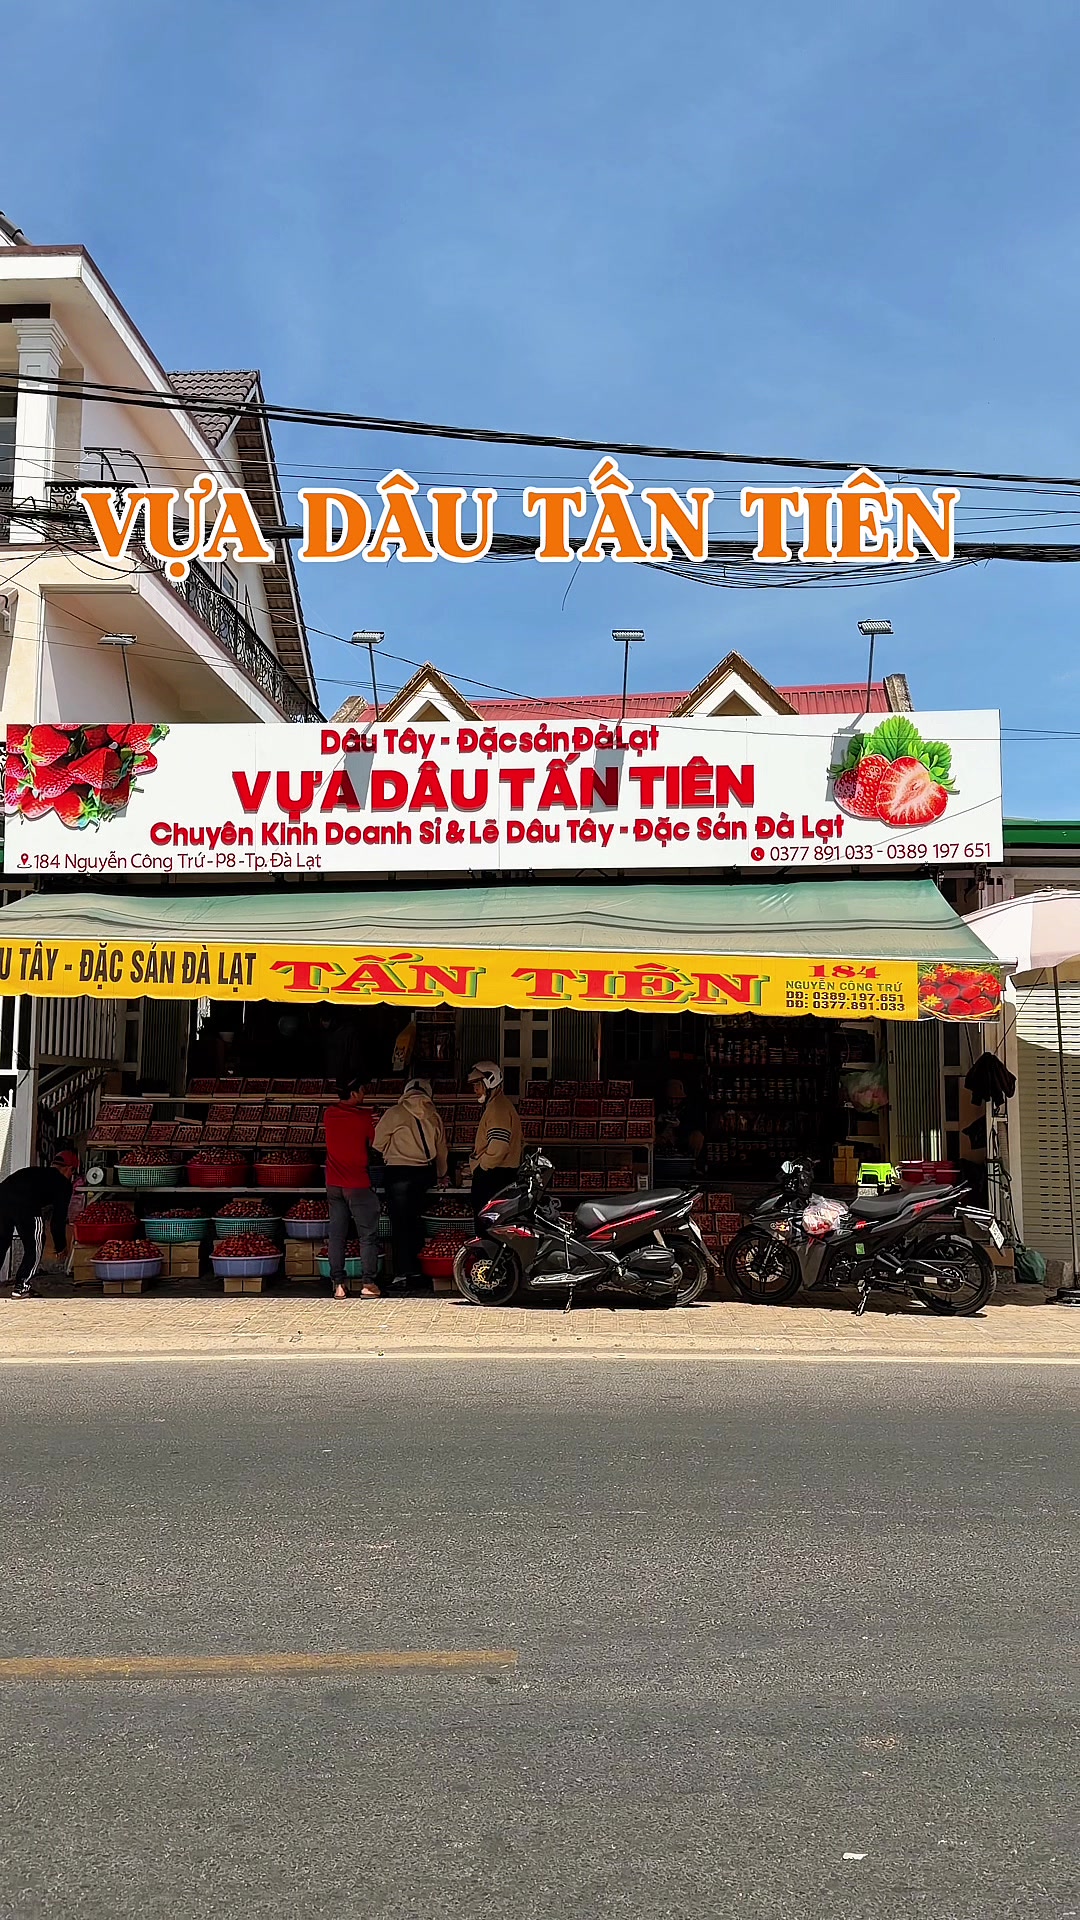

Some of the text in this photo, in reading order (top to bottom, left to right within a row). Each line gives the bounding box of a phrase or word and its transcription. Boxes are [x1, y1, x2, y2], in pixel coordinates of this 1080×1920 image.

[321, 727, 377, 755] Dâu
[384, 728, 435, 759] Tây
[232, 753, 754, 824] VỰA DÂU TẤN TIÊN
[150, 820, 253, 850] Chuyên
[262, 822, 318, 846] Kinh
[325, 821, 411, 845] Doanh
[446, 820, 465, 844] &
[507, 818, 560, 844] Dâu
[567, 818, 614, 847] Tây
[633, 816, 690, 847] Đặc
[697, 812, 747, 841] Sản
[755, 812, 795, 840] Đà
[802, 814, 844, 844] Lạt
[34, 854, 60, 869] 184
[65, 850, 127, 872] Nguyễn
[131, 853, 173, 872] Công
[297, 852, 321, 870] Lạt
[770, 846, 809, 861] 0377
[814, 846, 840, 861] 891
[846, 845, 873, 860] 033
[887, 844, 927, 859] 0389
[933, 843, 959, 859] 197
[964, 843, 991, 858] 651
[19, 941, 59, 981] TÂY
[79, 942, 124, 990] ĐẶC
[182, 944, 211, 985] ĐÀ
[218, 951, 257, 992] LẠT
[808, 964, 882, 979] 184
[268, 952, 770, 1006] TẤN TIÊN
[839, 980, 873, 991] CÔNG
[877, 981, 903, 992] TRỨ
[812, 991, 904, 1002] 0389.197.651
[812, 1000, 905, 1011] 0377.891.033
